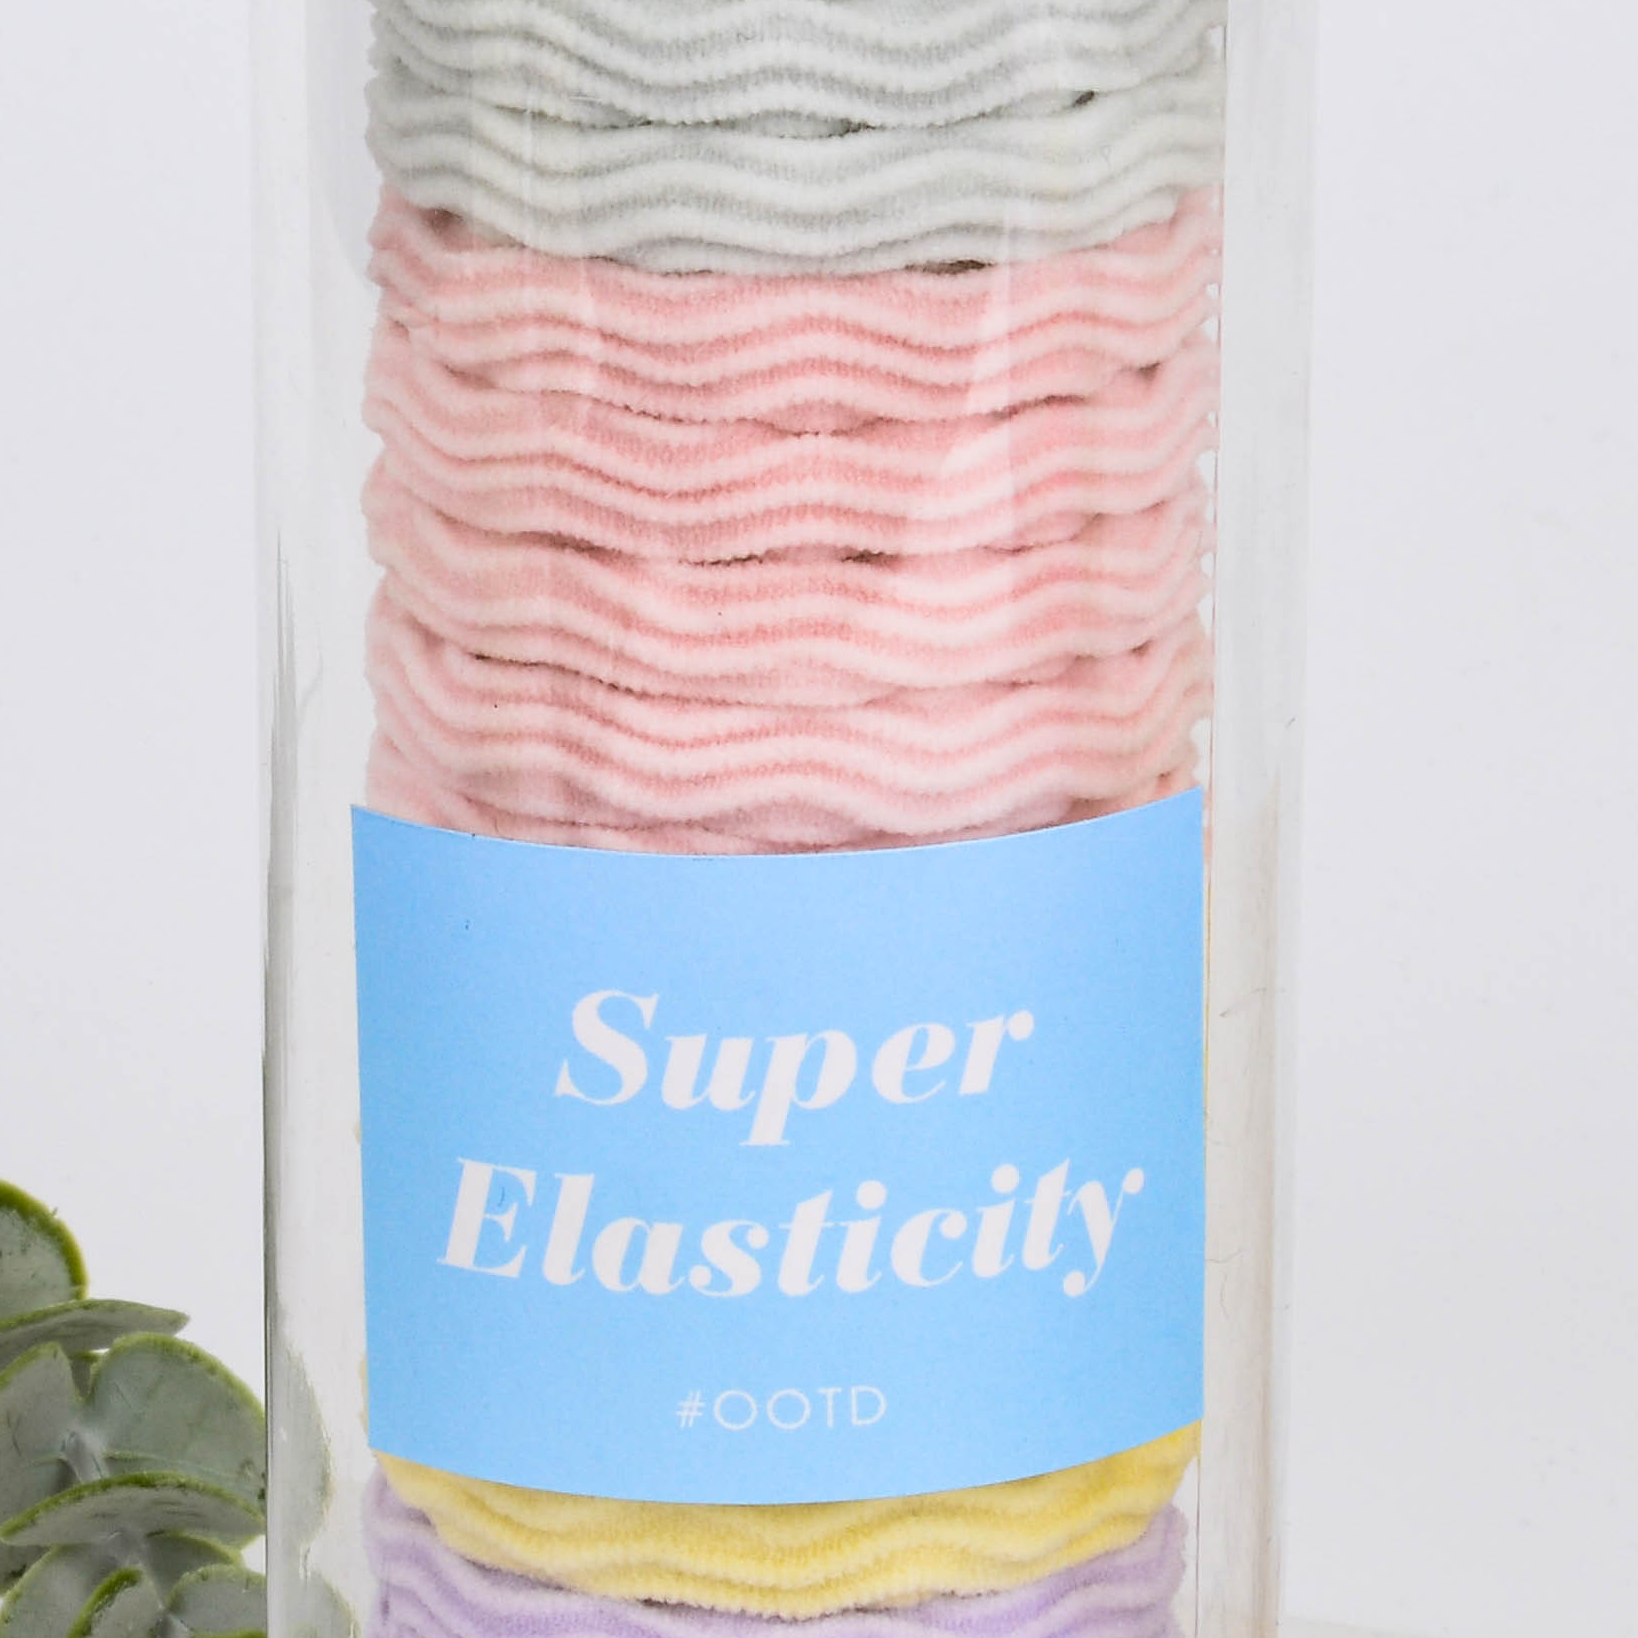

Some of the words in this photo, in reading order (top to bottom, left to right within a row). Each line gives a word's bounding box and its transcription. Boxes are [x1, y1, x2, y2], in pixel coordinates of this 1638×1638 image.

[552, 988, 1035, 1147] Super
[435, 1157, 1145, 1298] Elasticity
[675, 1384, 888, 1432] #OOTD
